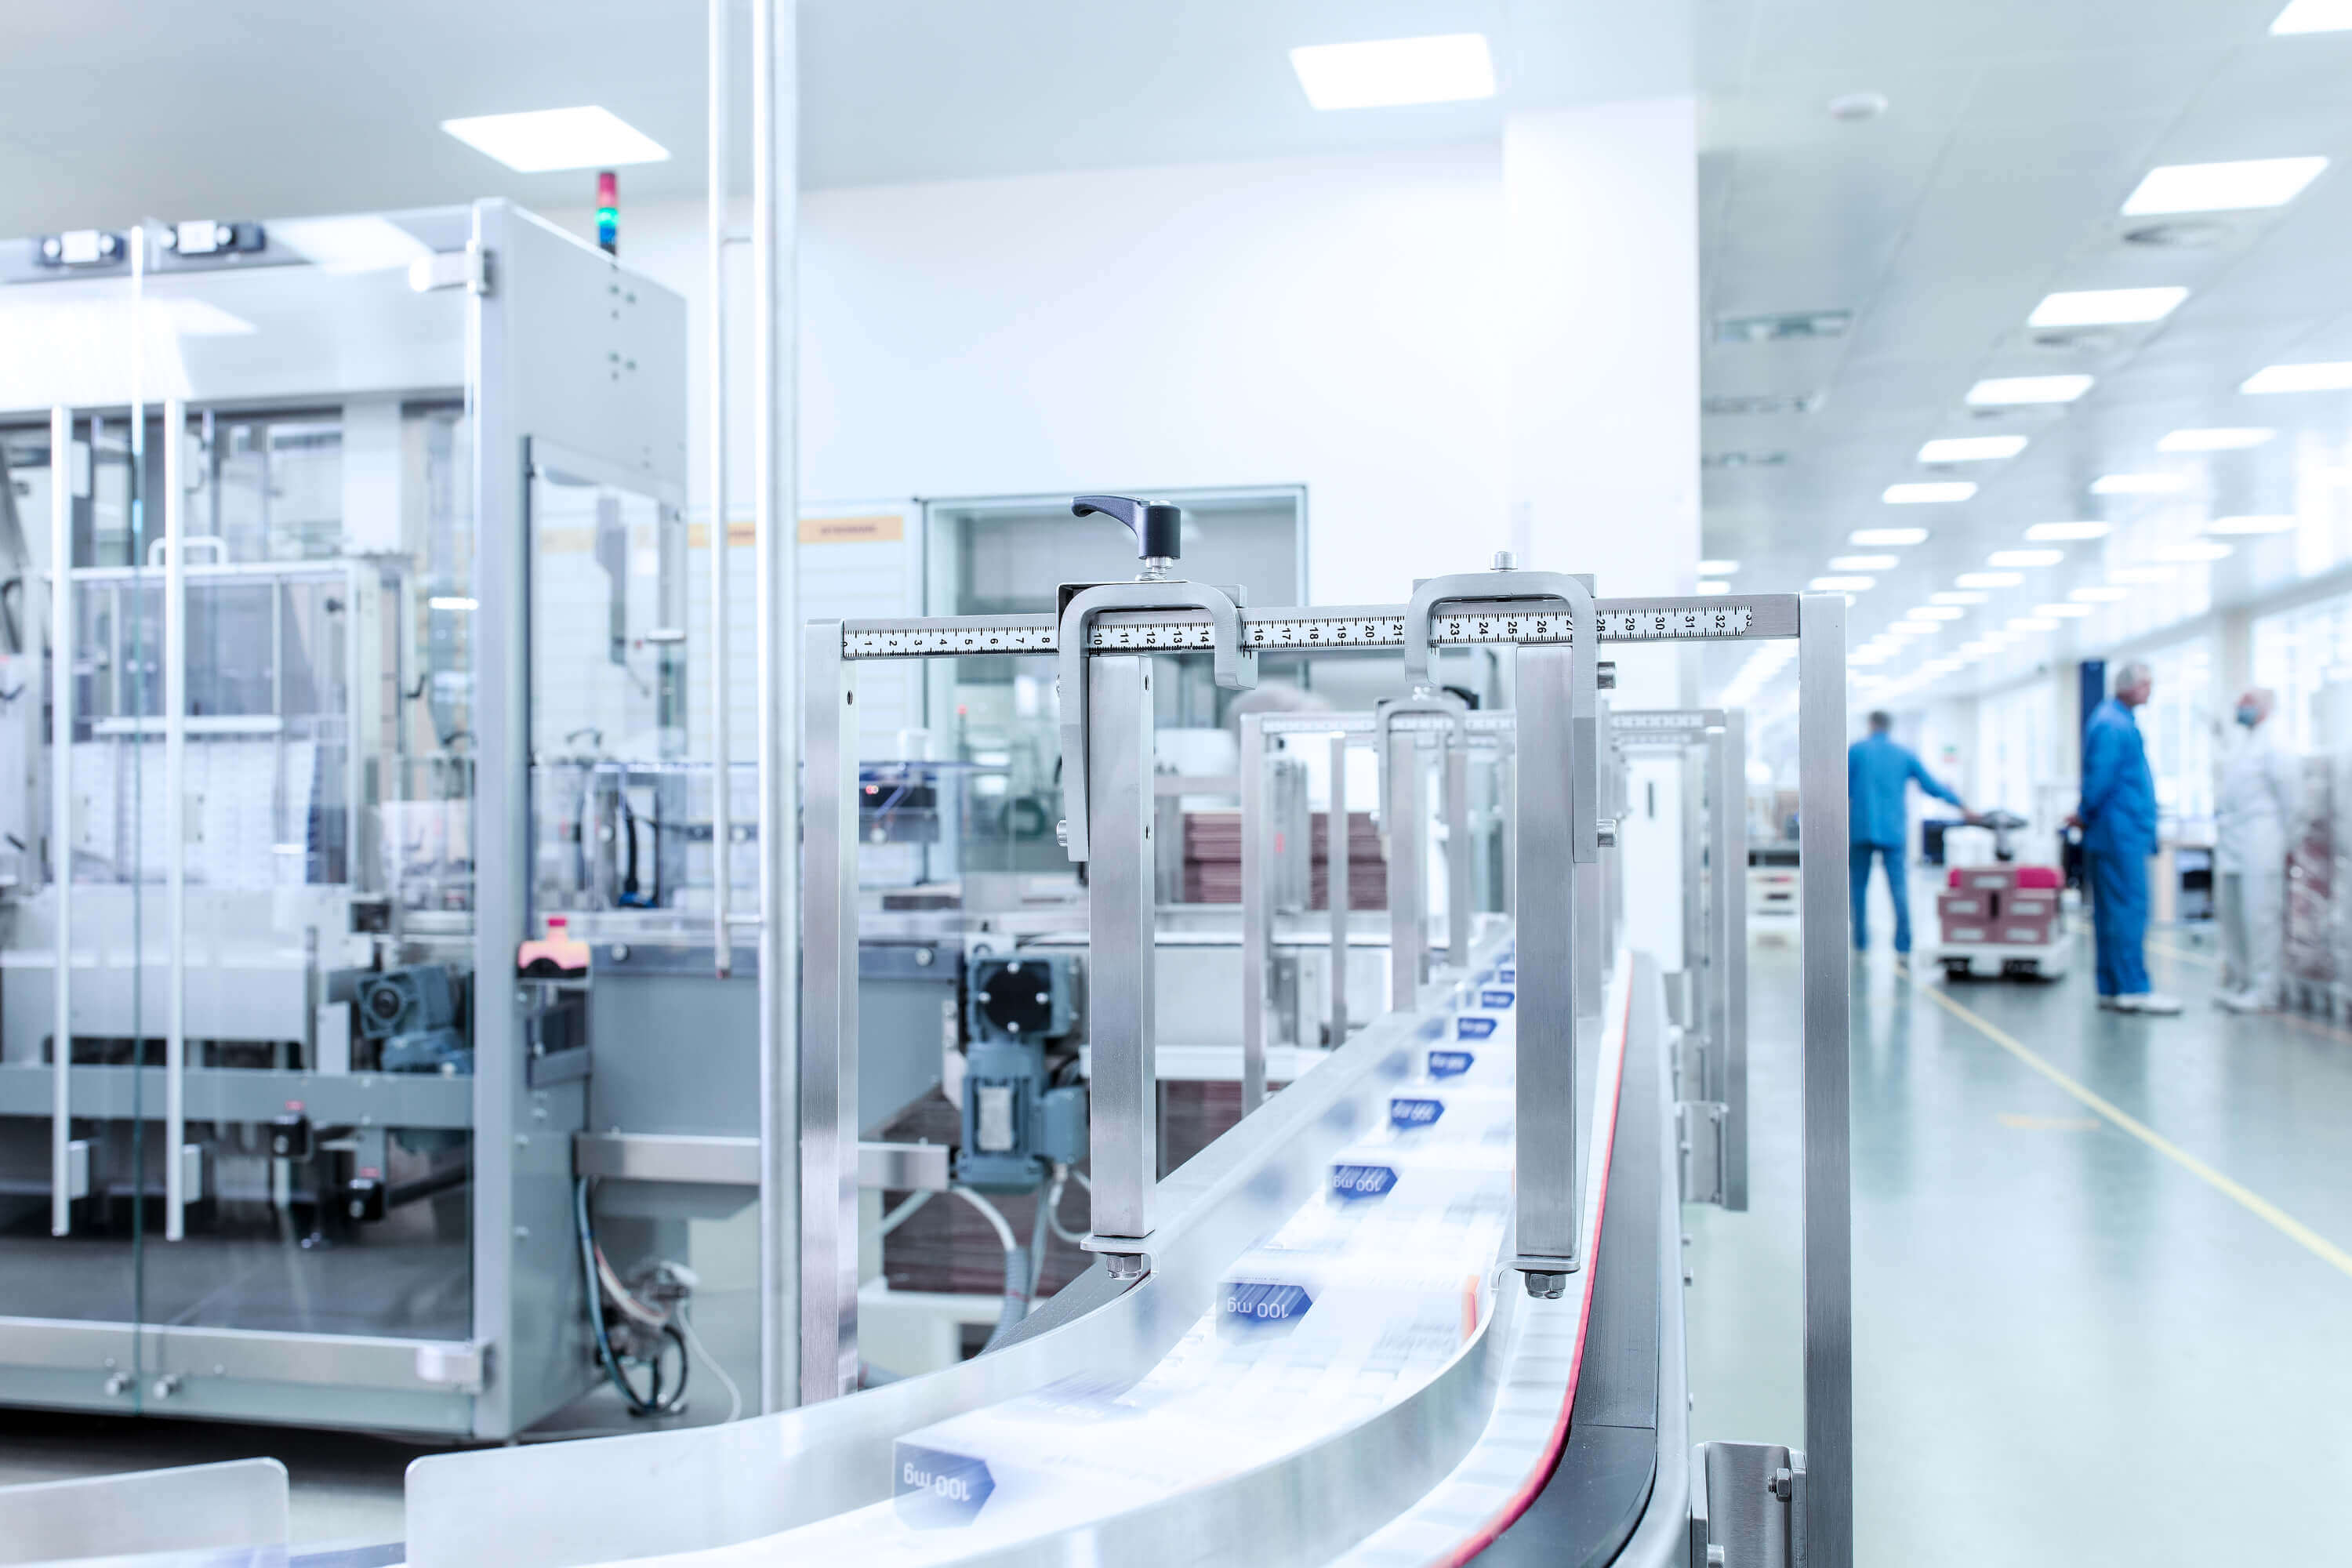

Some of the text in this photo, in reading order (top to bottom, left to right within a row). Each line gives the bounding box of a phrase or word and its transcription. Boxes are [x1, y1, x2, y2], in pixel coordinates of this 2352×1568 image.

[1094, 633, 1102, 645] 10
[1120, 633, 1129, 644] 11
[1146, 631, 1156, 644] 12
[1173, 631, 1182, 644] 13
[1200, 630, 1210, 642] 14
[1254, 629, 1264, 641] 16
[1282, 627, 1291, 640] 17
[1309, 626, 1319, 640] 18
[1337, 626, 1347, 639] 19
[1365, 625, 1375, 638] 20
[1393, 624, 1403, 637] 21
[1450, 622, 1460, 636] 23
[1479, 622, 1489, 635] 24
[1508, 621, 1518, 634] 25
[1537, 620, 1547, 633] 26
[1596, 619, 1606, 632] 28
[1625, 618, 1635, 631] 29
[1655, 617, 1665, 630] 30
[1685, 615, 1695, 628] 31
[1715, 615, 1725, 628] 32
[1227, 1297, 1289, 1319] 100 mg
[903, 1461, 971, 1502] 100 mg
